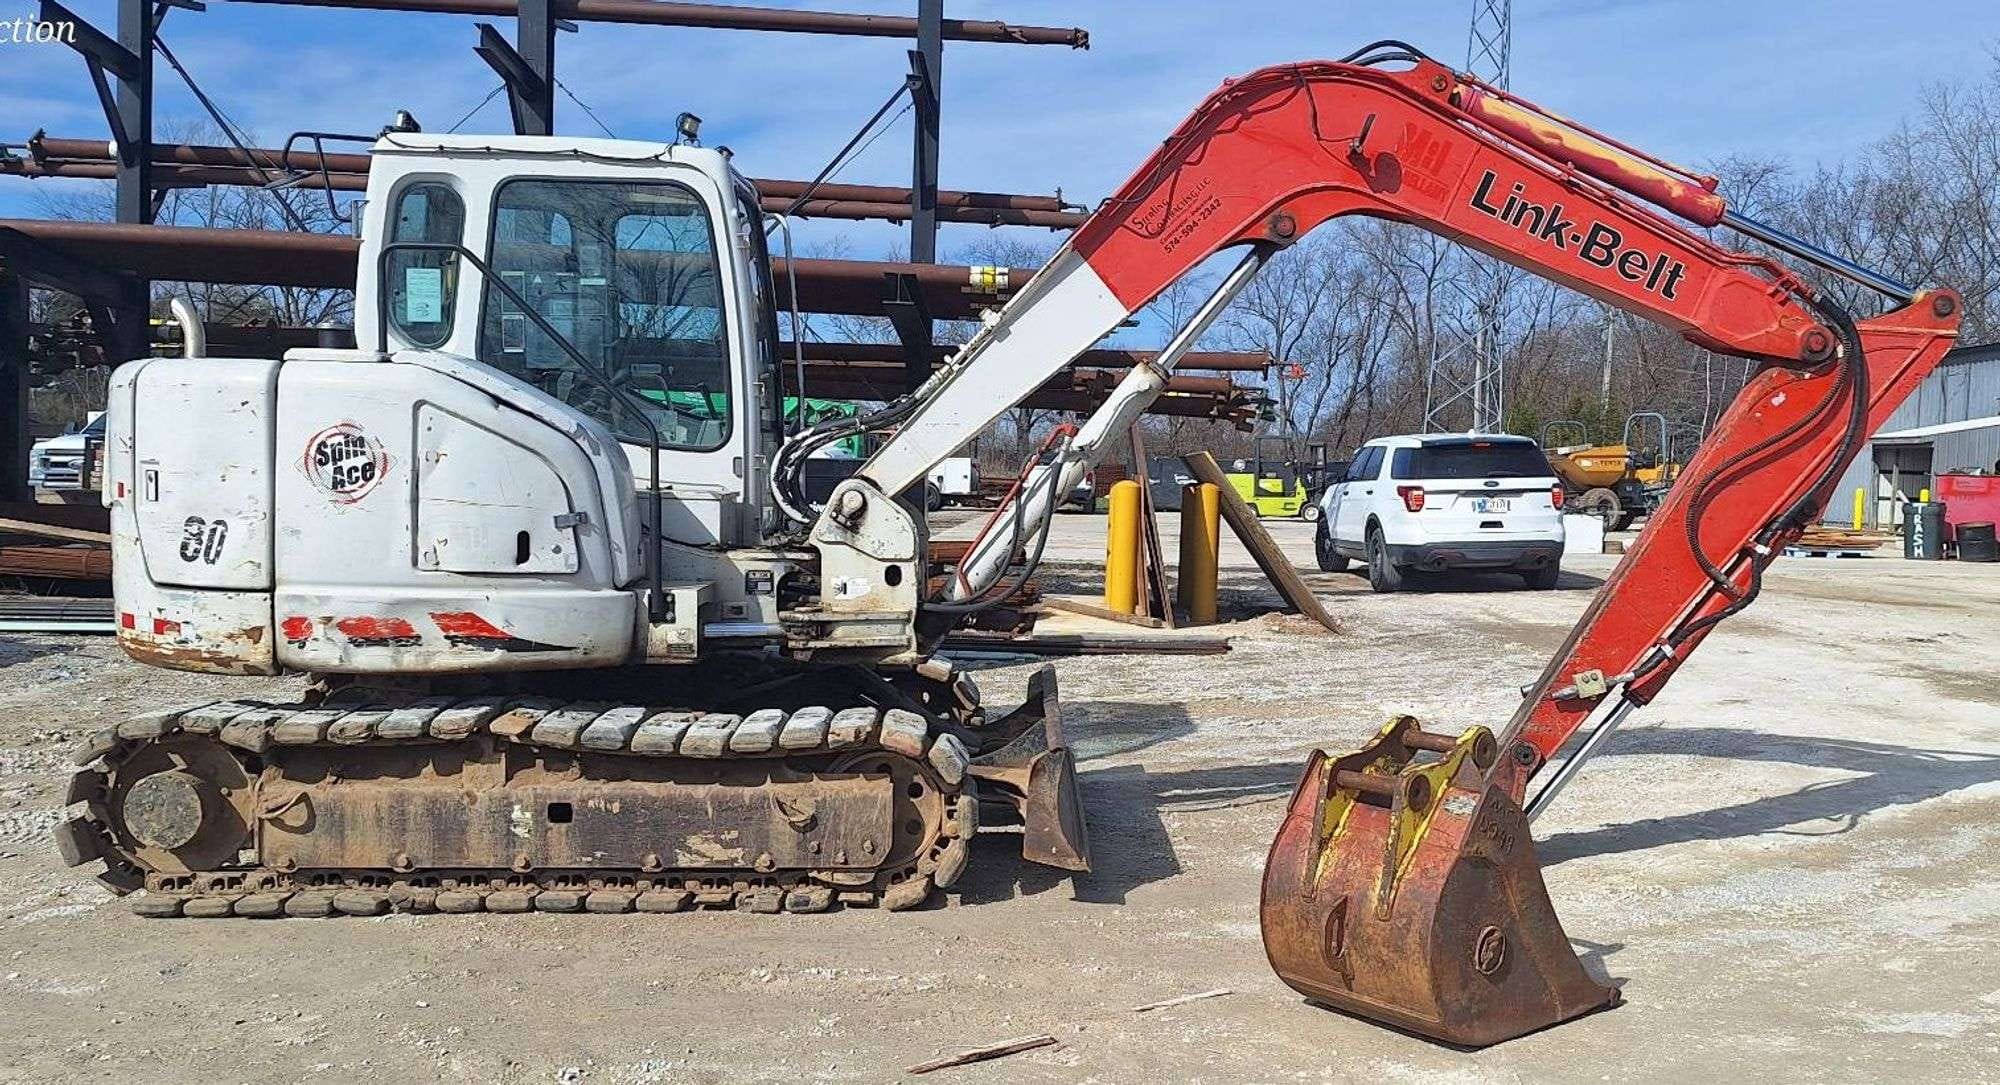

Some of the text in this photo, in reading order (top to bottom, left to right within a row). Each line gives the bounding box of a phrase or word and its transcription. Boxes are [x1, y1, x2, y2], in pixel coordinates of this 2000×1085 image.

[1164, 199, 1221, 254] 574-594-2342
[1469, 168, 1686, 300] Link-Belt
[316, 433, 367, 467] Spin
[331, 461, 376, 491] Ace
[180, 515, 228, 566] 80
[1912, 502, 1925, 558] TRASH
